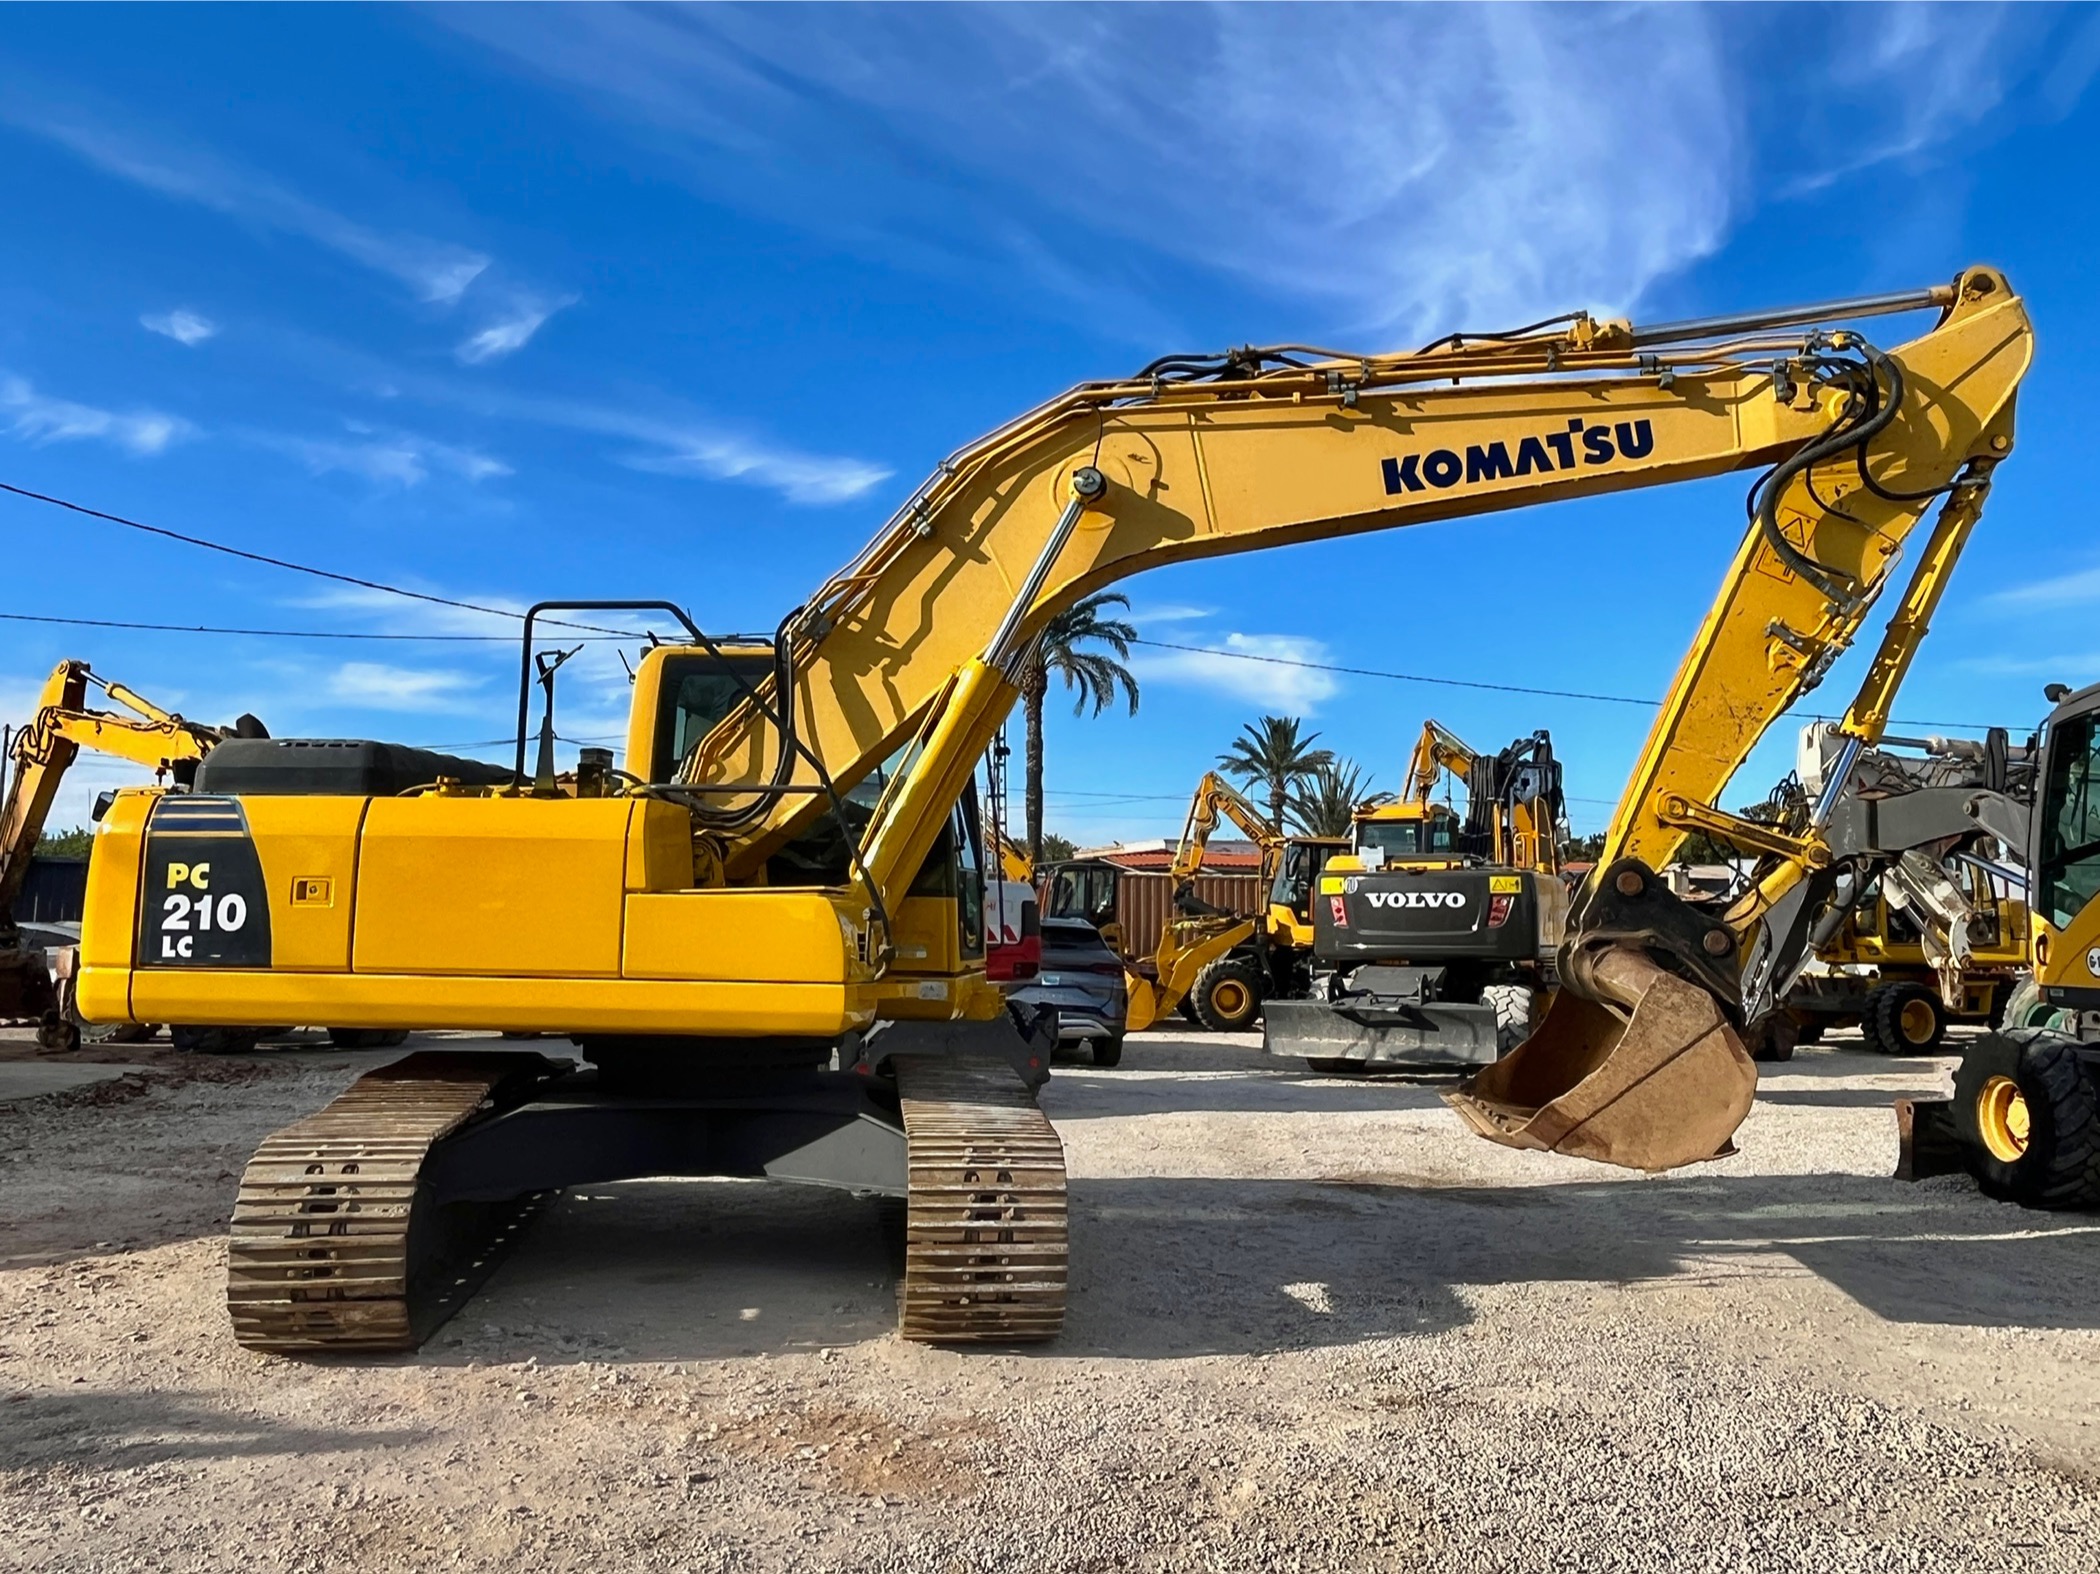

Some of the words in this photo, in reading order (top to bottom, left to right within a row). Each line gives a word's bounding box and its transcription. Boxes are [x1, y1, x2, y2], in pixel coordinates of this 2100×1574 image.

[1381, 418, 1654, 496] KOMATSU
[166, 863, 210, 889] PC
[161, 893, 247, 932] 210
[1365, 892, 1466, 908] VOLVO
[161, 935, 193, 958] LC
